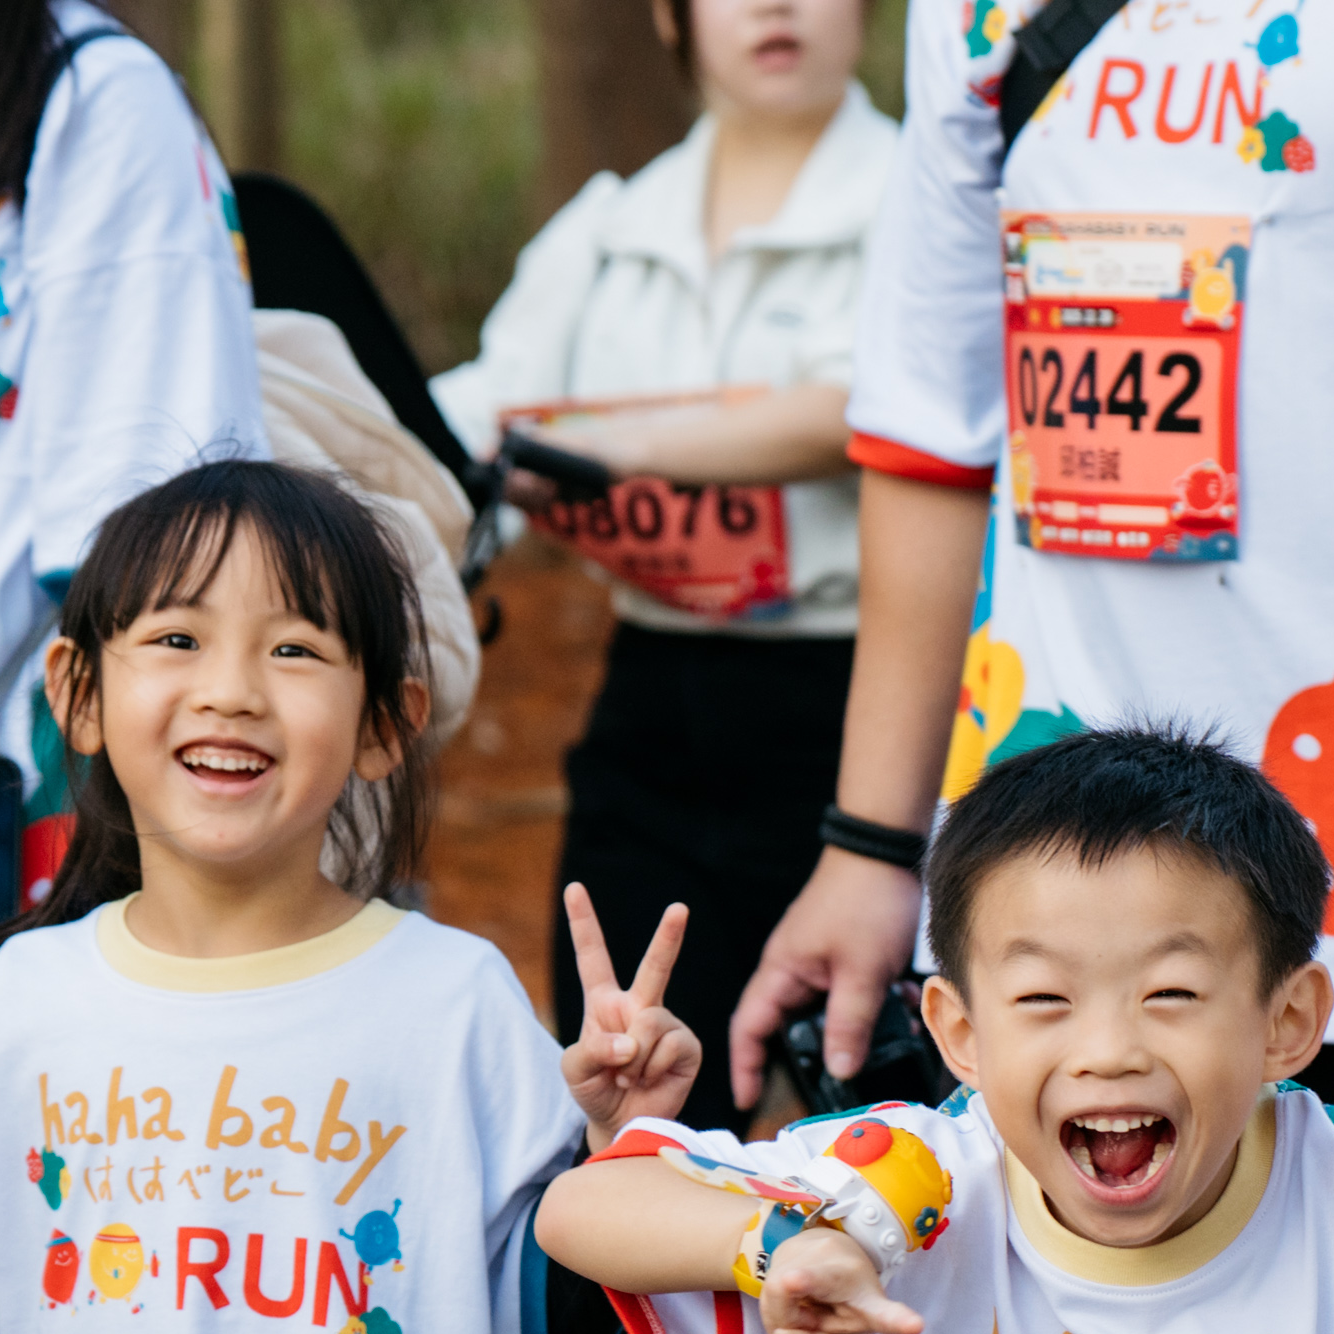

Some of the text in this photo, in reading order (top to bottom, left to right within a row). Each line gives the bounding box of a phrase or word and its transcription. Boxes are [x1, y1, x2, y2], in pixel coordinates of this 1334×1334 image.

[1089, 57, 1263, 144] RUN
[1019, 346, 1202, 433] 02442
[39, 1065, 407, 1205] haha baby
[176, 1227, 368, 1326] RUN
